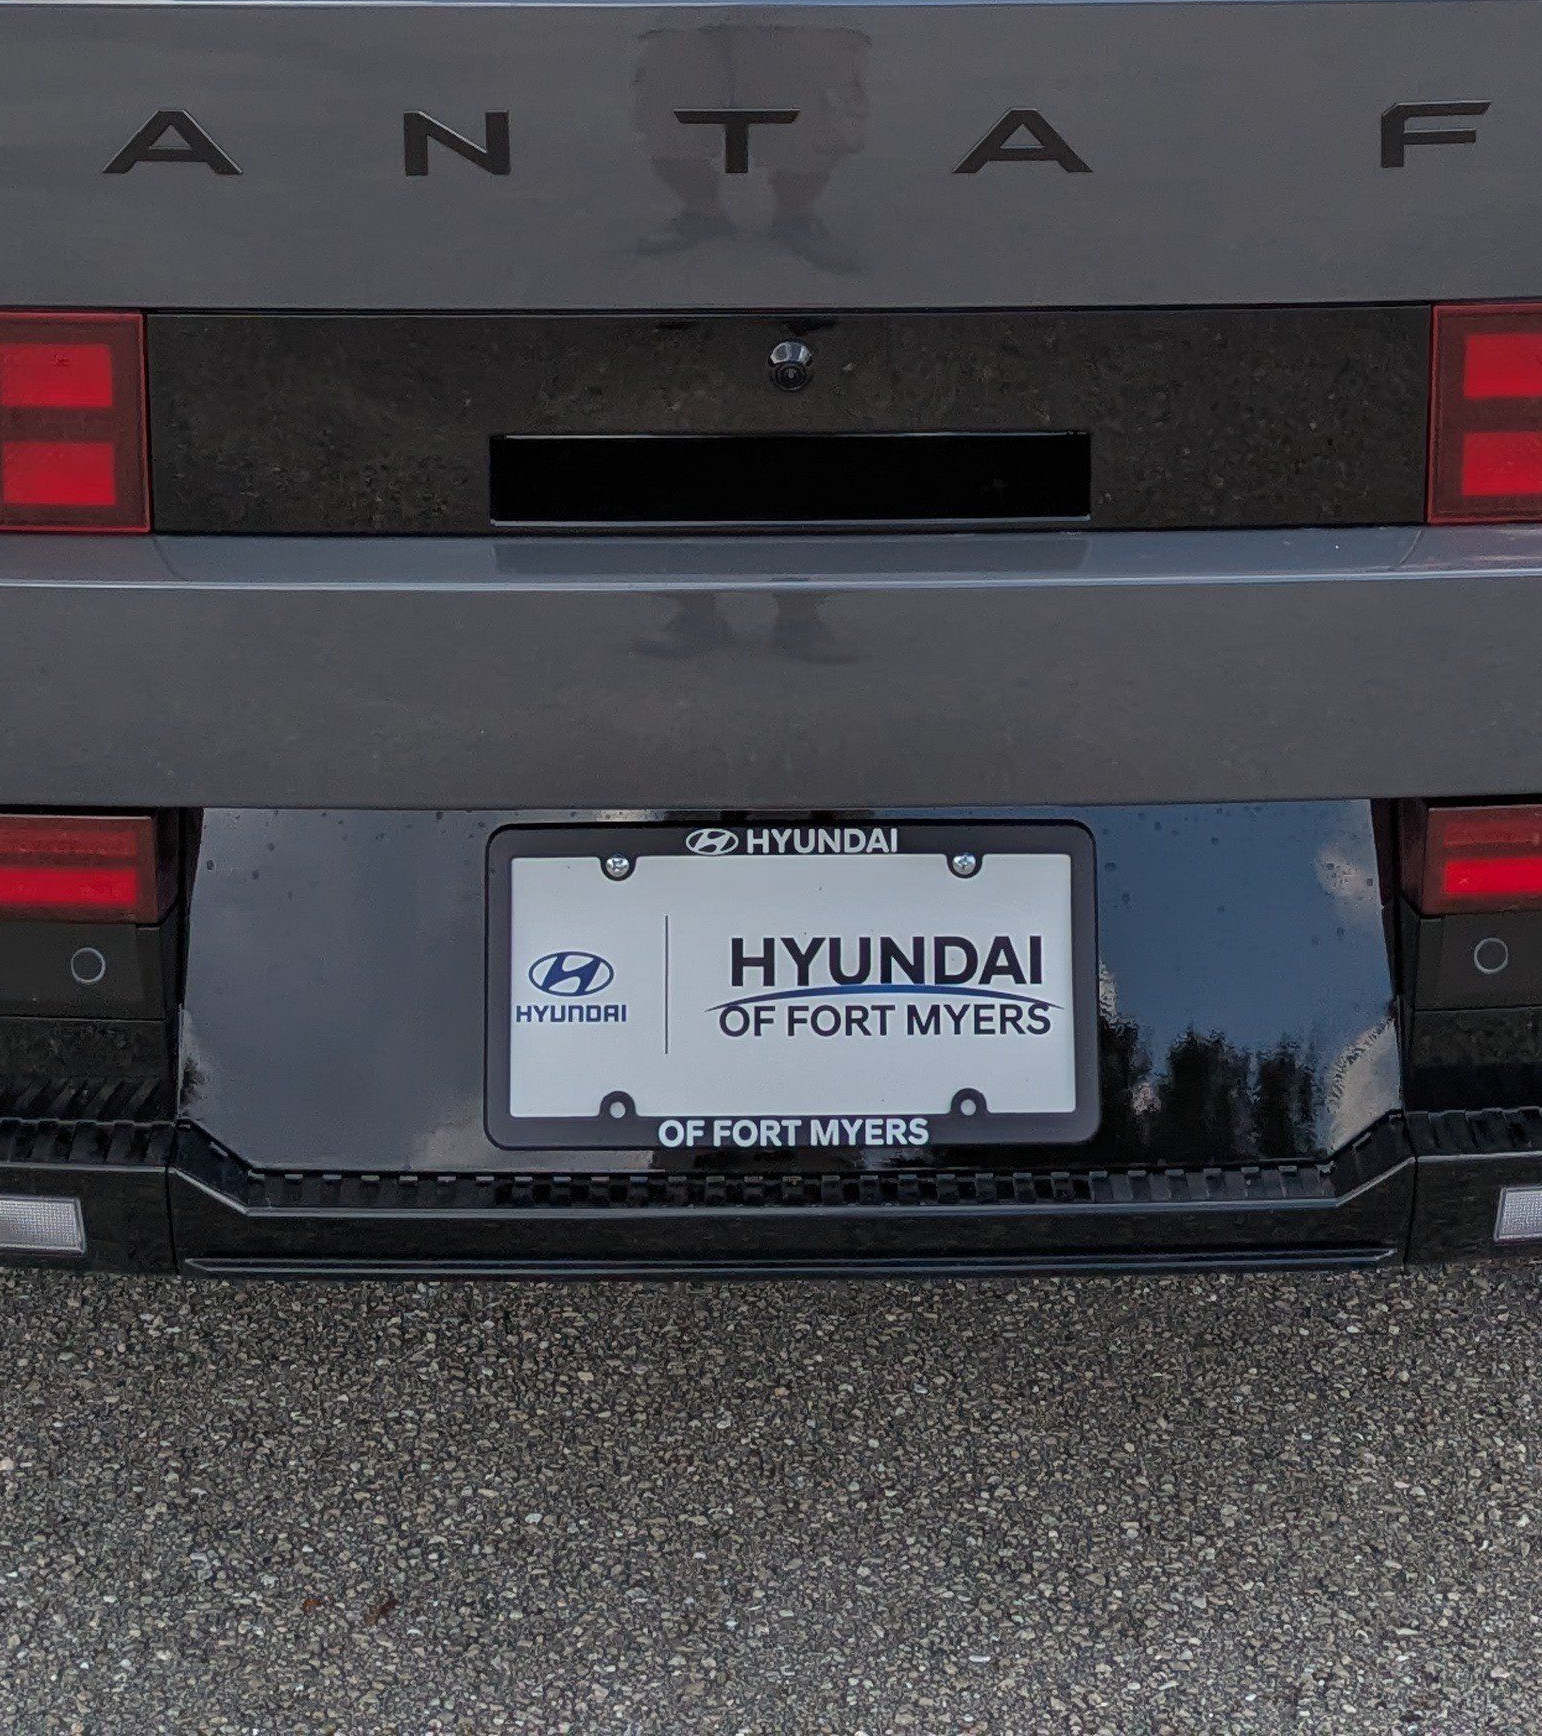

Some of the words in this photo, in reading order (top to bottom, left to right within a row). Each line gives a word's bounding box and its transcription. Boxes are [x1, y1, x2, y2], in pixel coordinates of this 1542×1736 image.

[746, 828, 898, 855] HYUNDAI
[730, 935, 1043, 988] HYUNDAI
[515, 1004, 627, 1023] HYUNDAI
[719, 1004, 776, 1038] OF
[787, 1004, 896, 1037] FORT
[907, 1003, 1052, 1036] MYERS
[658, 1119, 706, 1148] OF
[713, 1119, 803, 1147] FORT
[810, 1117, 930, 1147] MYERS
